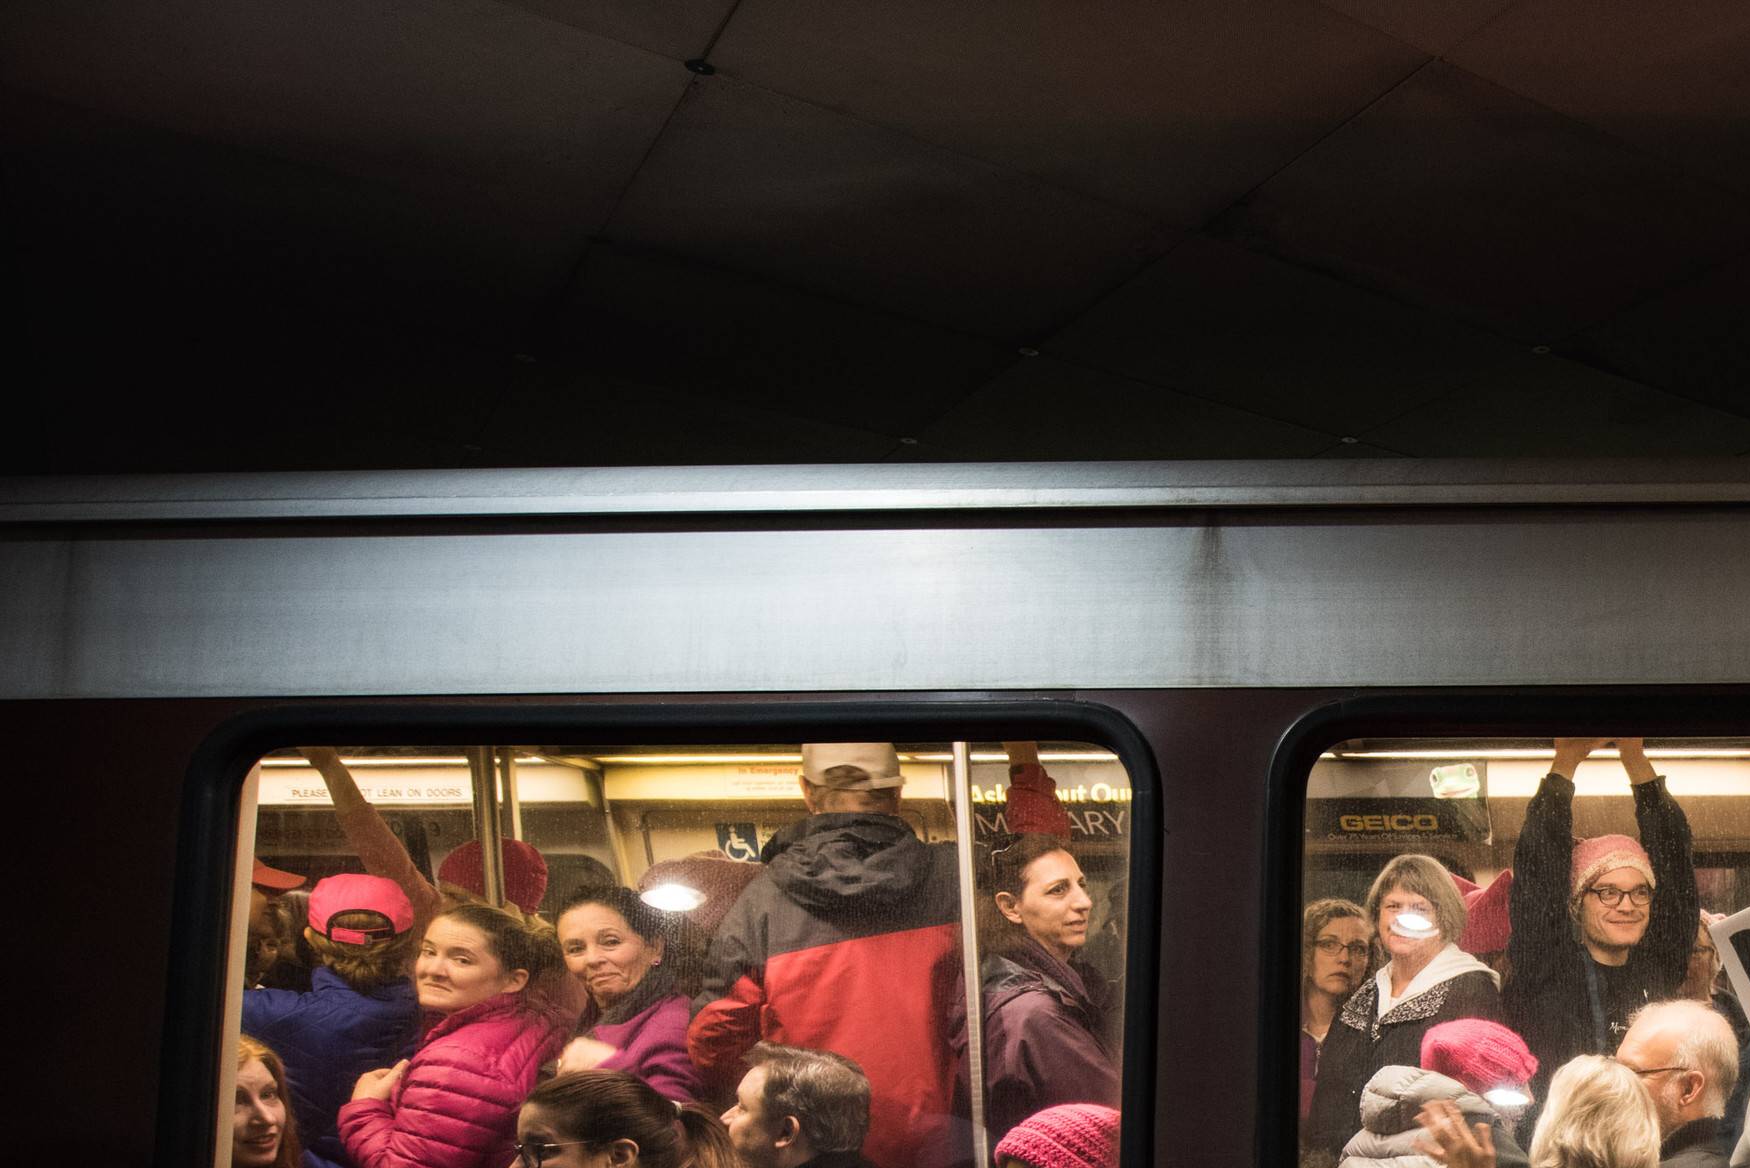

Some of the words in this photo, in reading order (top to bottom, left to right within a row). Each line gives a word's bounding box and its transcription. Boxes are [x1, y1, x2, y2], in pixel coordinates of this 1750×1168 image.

[291, 788, 328, 798] PLEASE
[377, 788, 402, 798] LEAN
[407, 788, 422, 798] ON
[427, 788, 464, 798] DOORS
[1339, 814, 1439, 832] GEICO
